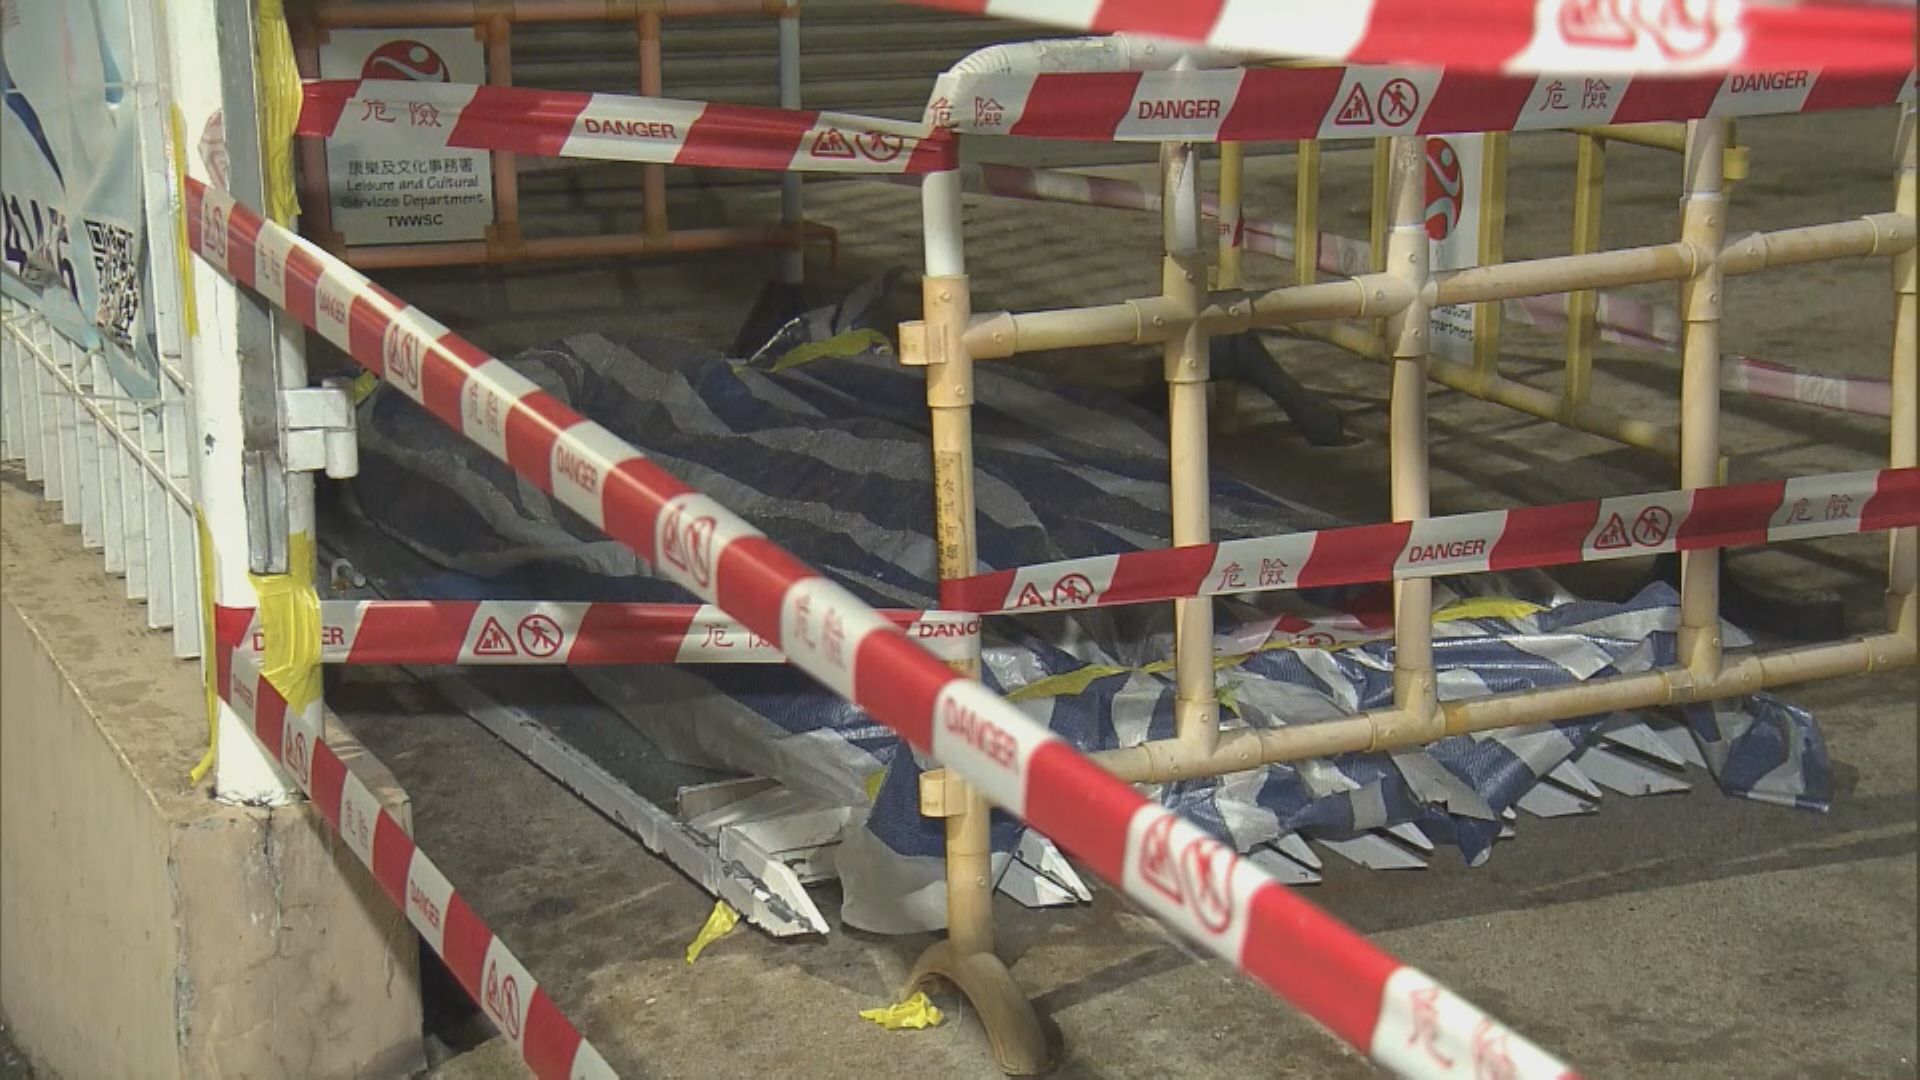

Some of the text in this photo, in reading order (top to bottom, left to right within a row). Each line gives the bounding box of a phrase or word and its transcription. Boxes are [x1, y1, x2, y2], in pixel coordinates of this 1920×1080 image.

[1540, 77, 1612, 111] 危險
[1730, 70, 1808, 94] DANGER
[1138, 100, 1221, 120] DANGER
[584, 118, 678, 140] DANGER
[347, 175, 479, 192] Leisure and Cultural
[403, 193, 485, 210] Department
[385, 214, 444, 228] TWWSC
[556, 446, 598, 493] DANGER
[1408, 539, 1487, 563] DANGER
[1217, 557, 1289, 591] 危險
[252, 626, 345, 651] DER
[944, 696, 1019, 770] DANGER
[409, 878, 441, 928] DANGER
